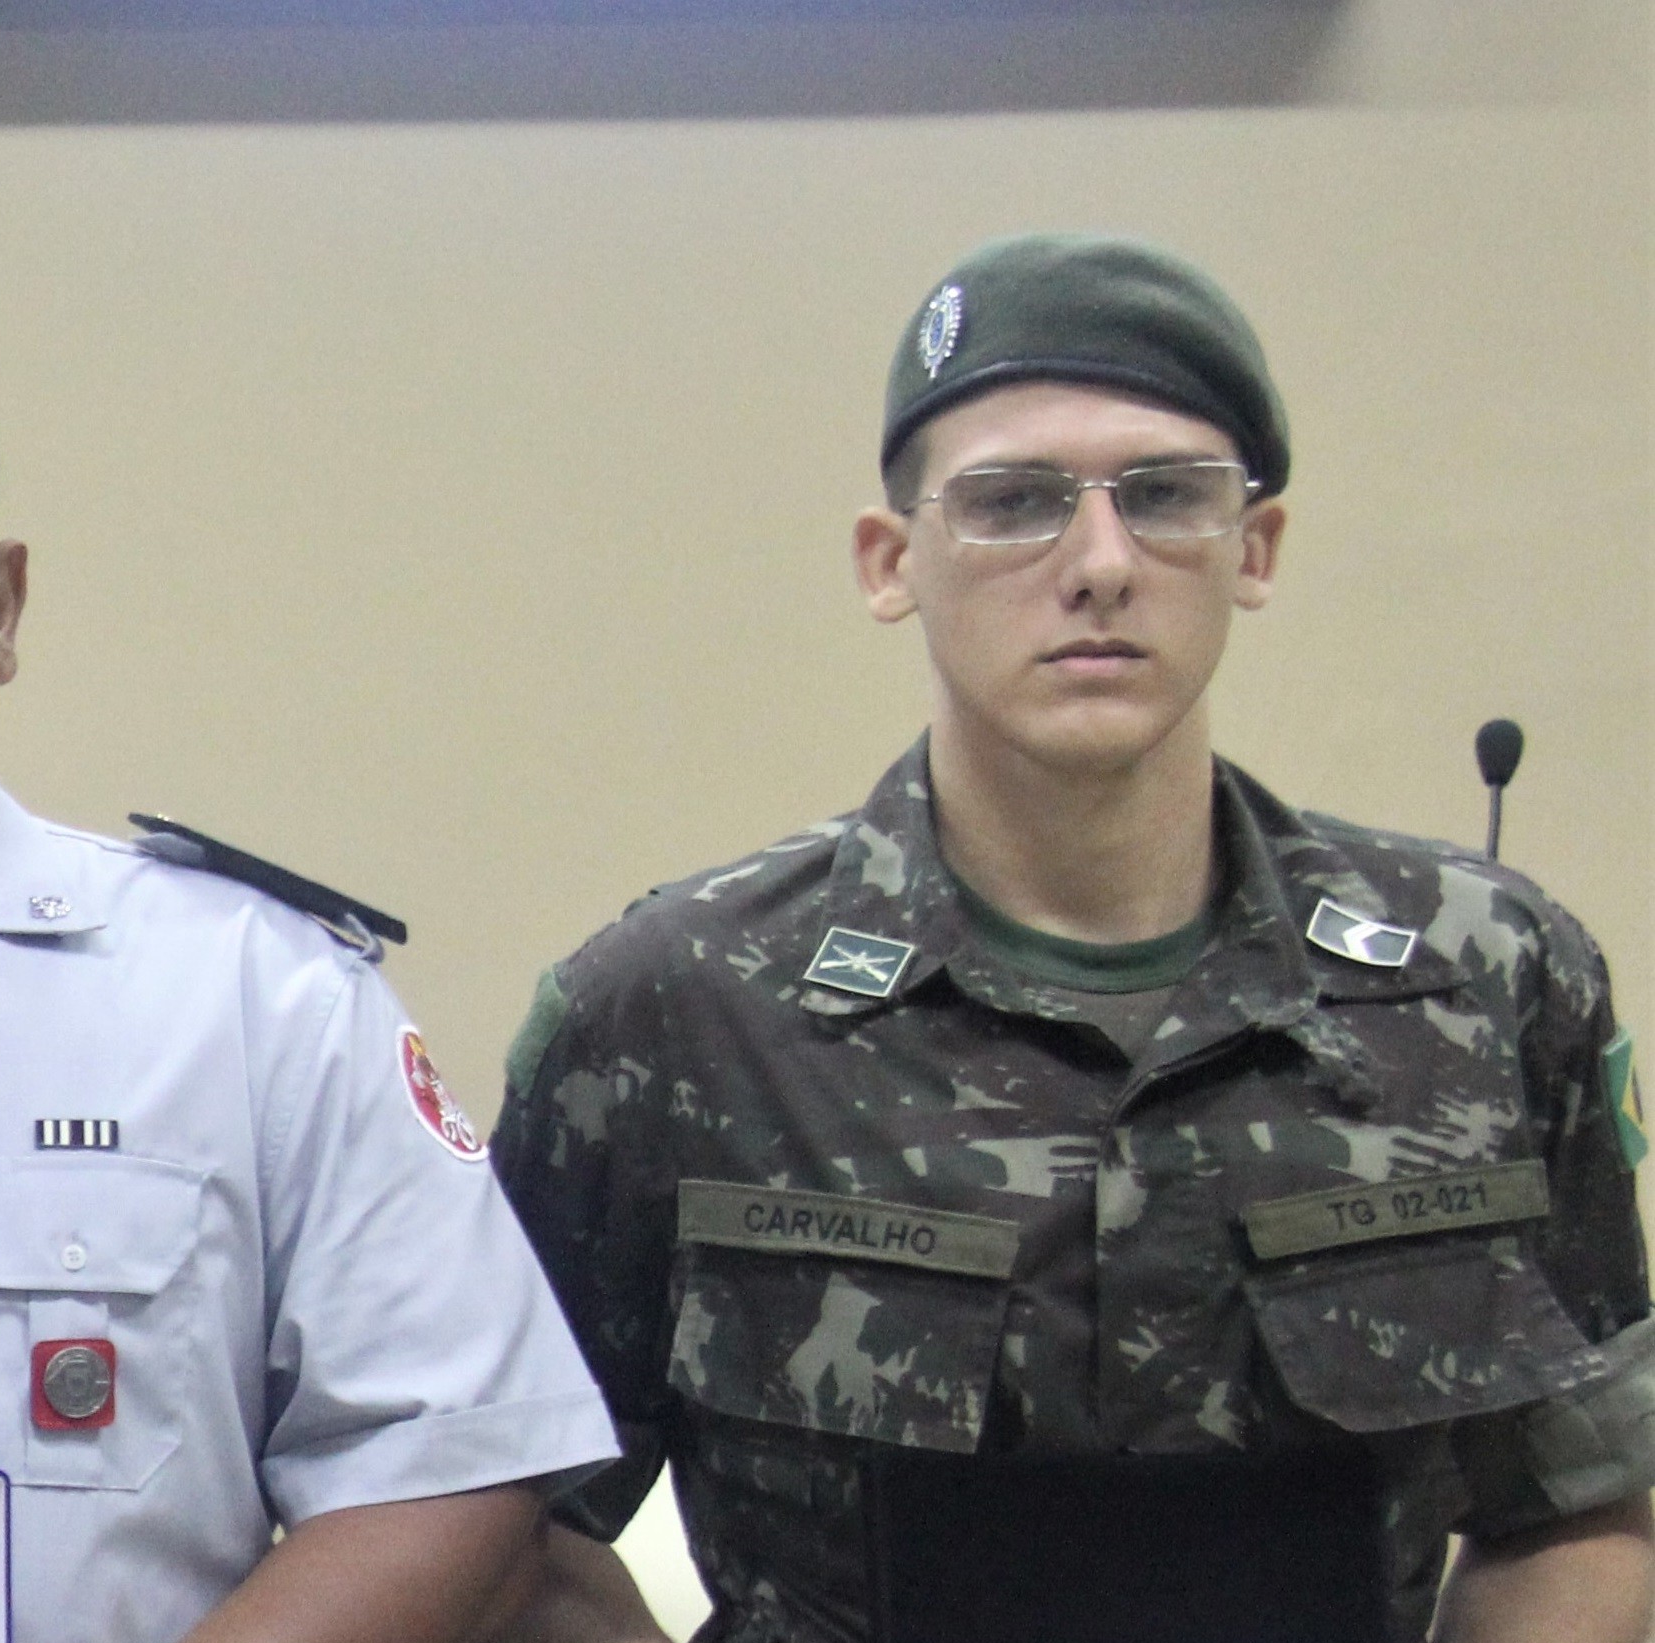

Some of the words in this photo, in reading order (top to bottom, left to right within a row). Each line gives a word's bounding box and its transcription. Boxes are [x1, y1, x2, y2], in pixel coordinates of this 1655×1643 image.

[744, 1202, 936, 1255] CARVALHO
[1326, 1198, 1376, 1230] TG
[1391, 1182, 1487, 1220] 02-021
